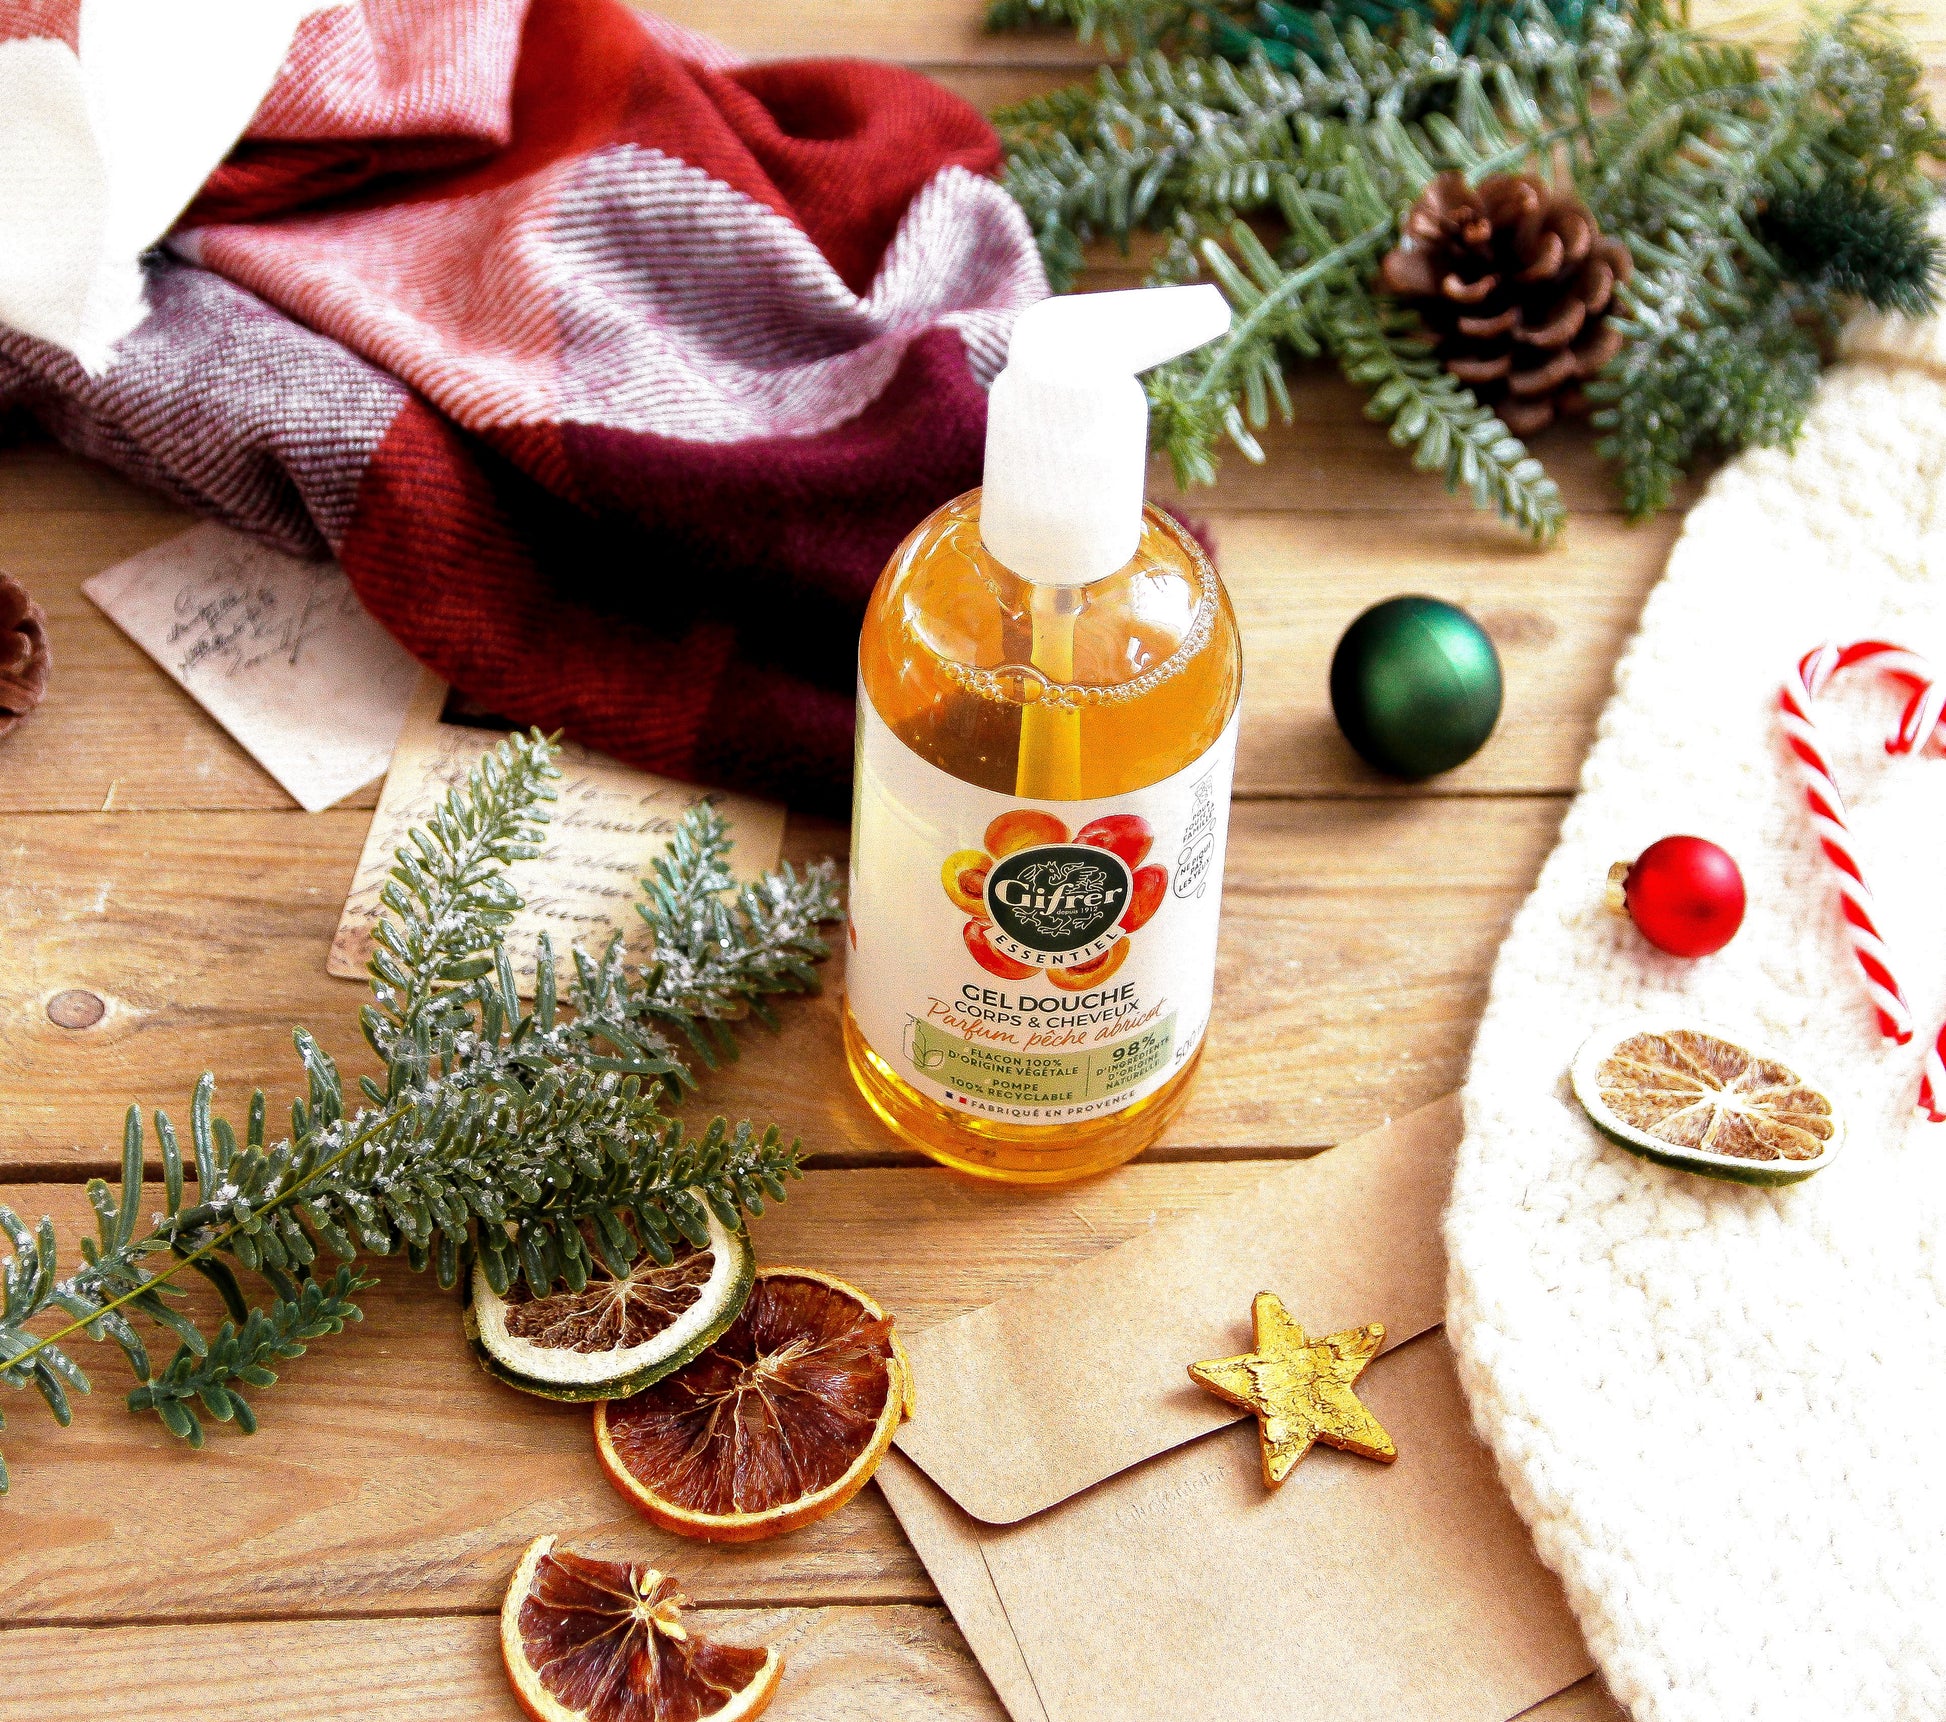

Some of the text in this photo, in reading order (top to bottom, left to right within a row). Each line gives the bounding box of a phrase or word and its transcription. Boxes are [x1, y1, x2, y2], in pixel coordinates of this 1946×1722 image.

[1185, 811, 1206, 834] TOUTE
[1180, 862, 1191, 876] NE
[1190, 859, 1203, 875] PAS
[994, 879, 1123, 916] Gifrer
[1178, 877, 1192, 892] LES
[1080, 906, 1098, 914] 1912
[995, 930, 1118, 964] ESSENTIEL
[962, 982, 1136, 1013] GEL DOUCHE
[927, 996, 1168, 1052] Parfum pêche abricot
[954, 998, 1140, 1029] CORPS & CHEVEUX
[971, 1048, 1062, 1068] FLACON 100%
[1112, 1031, 1156, 1062] 98%
[948, 1049, 1079, 1077] D'ORIGINE VÉGÉTALE
[950, 1076, 1073, 1101] 100% RECYCLABLE
[992, 1079, 1039, 1092] POMPE
[971, 1090, 1136, 1118] FABRIQUÉ EN PROVENCE
